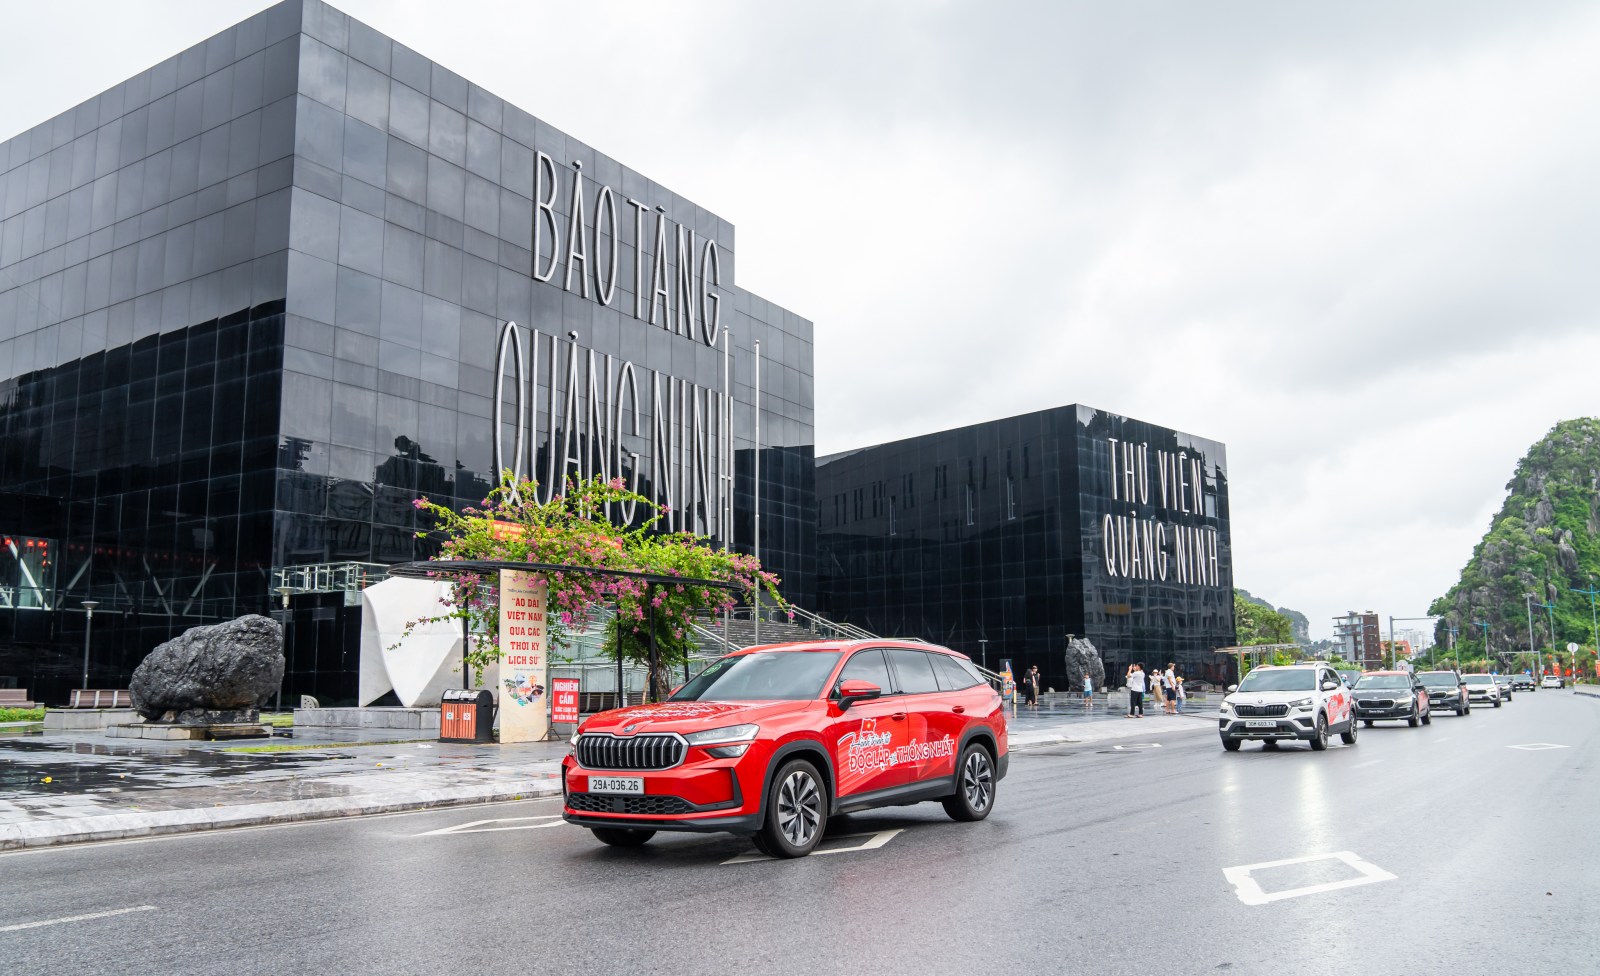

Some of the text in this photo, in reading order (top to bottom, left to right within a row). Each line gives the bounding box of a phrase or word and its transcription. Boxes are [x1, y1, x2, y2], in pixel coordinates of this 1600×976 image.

[533, 150, 720, 347] BẢO TÀNG
[493, 320, 734, 544] QUẢNG NINH
[1108, 437, 1203, 516] THƯ VIỆN
[1103, 510, 1219, 587] QUẢNG NINH
[528, 612, 543, 622] NAM
[509, 626, 526, 636] QUA
[554, 680, 579, 692] NGHIÊM
[559, 691, 574, 705] CẤM
[849, 749, 873, 774] ĐỘC
[873, 746, 890, 770] LẬP
[897, 739, 930, 763] THỐNG
[929, 734, 954, 759] NHẤT
[592, 779, 639, 791] 29A-036.26
